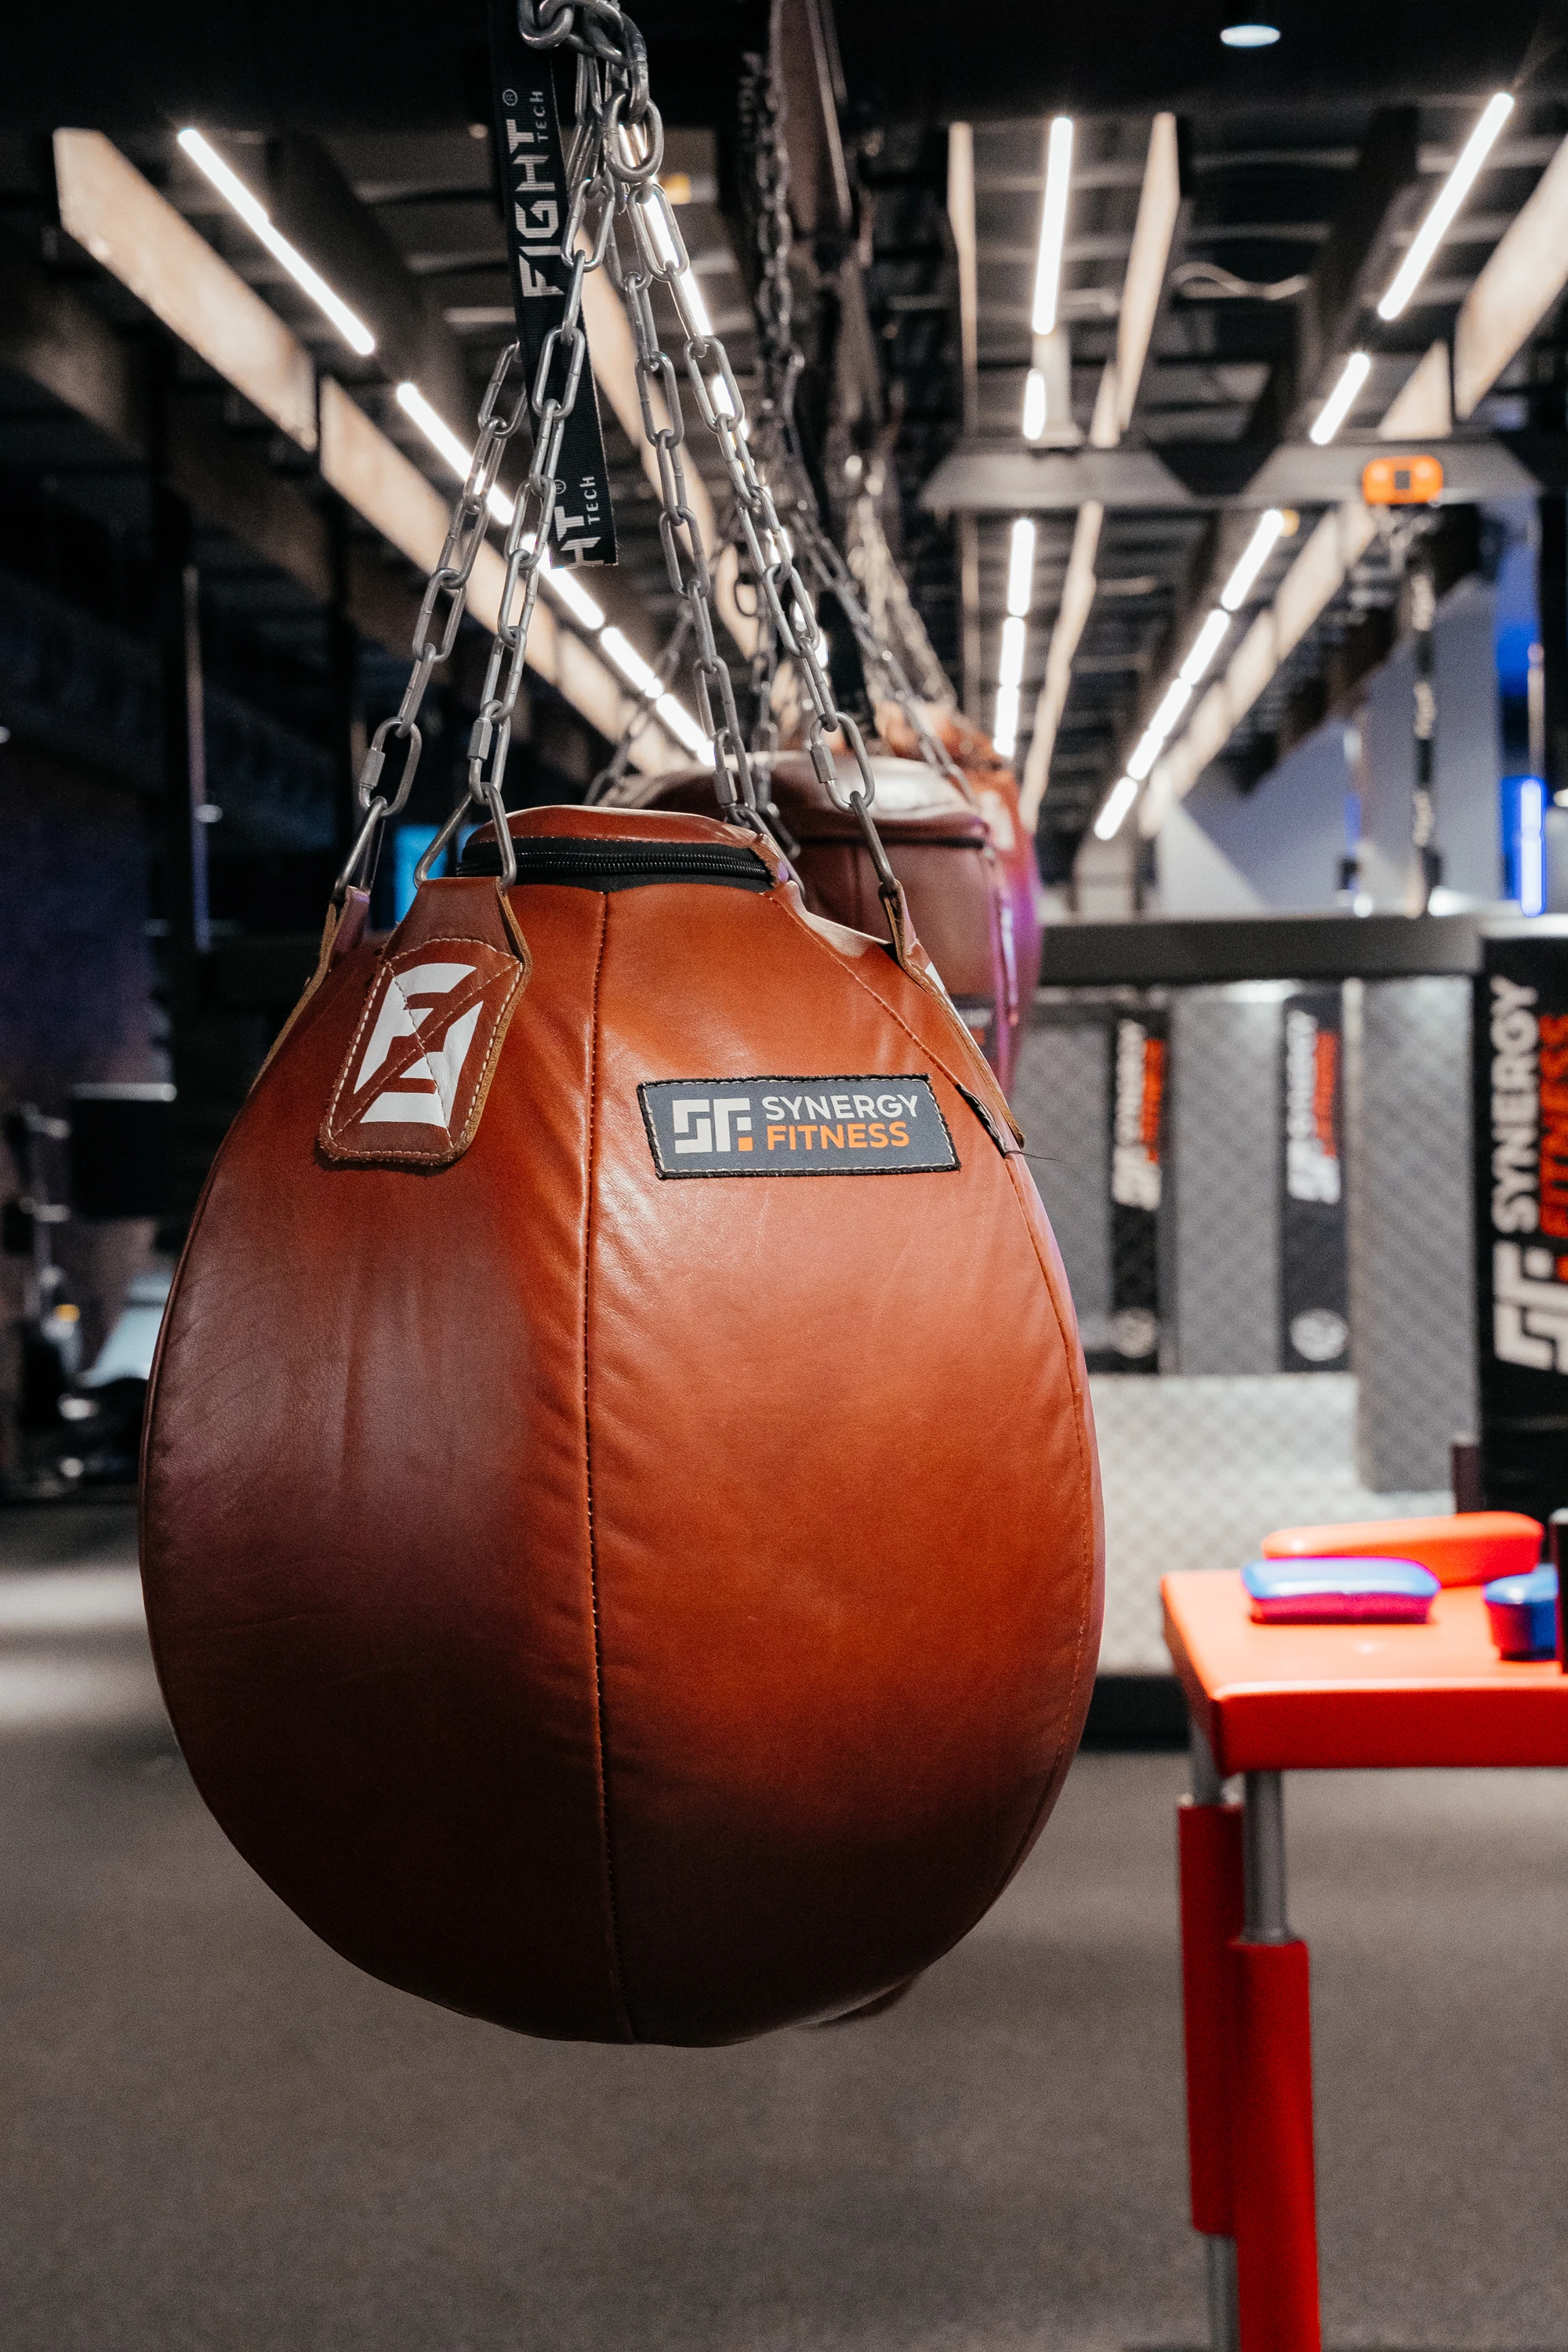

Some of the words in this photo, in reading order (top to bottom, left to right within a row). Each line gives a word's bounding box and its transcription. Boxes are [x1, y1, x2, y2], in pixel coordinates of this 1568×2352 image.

[529, 90, 550, 143] TECH
[506, 118, 565, 298] FIGHT
[579, 476, 601, 525] TECH
[761, 1094, 918, 1121] SYNERGY
[1490, 975, 1539, 1234] SYNERGY
[766, 1121, 910, 1151] FITNESS
